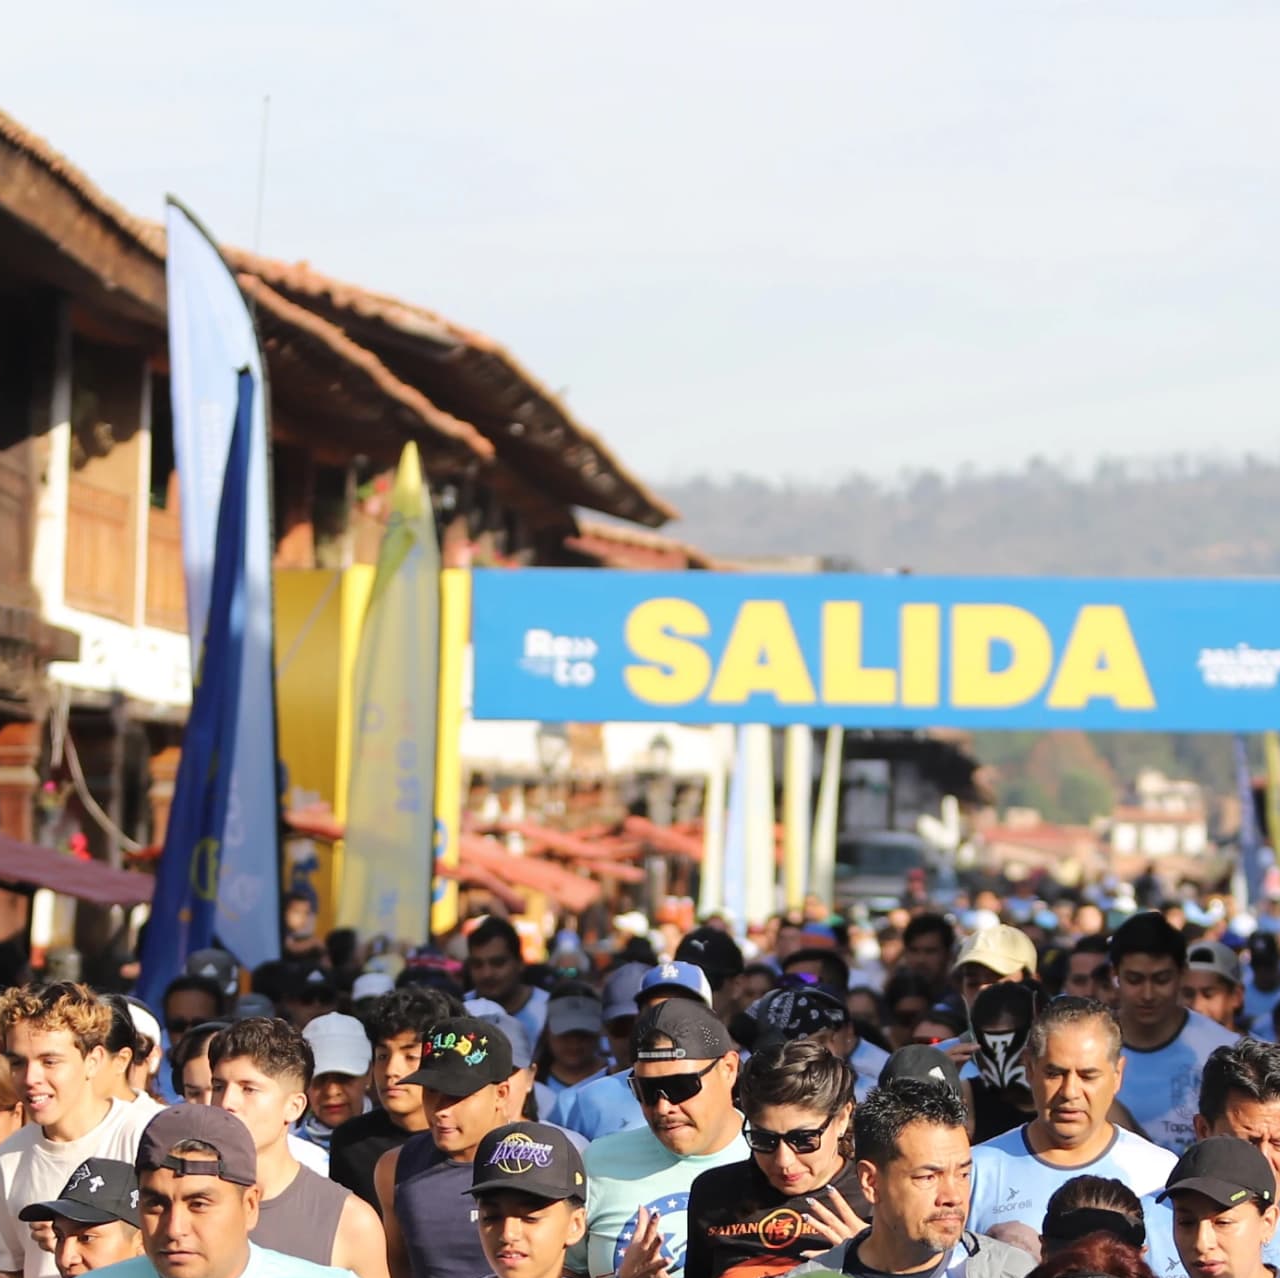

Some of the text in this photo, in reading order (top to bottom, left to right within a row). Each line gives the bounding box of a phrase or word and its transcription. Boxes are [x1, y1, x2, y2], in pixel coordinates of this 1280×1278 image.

[624, 597, 1157, 710] SALIDA
[484, 1140, 554, 1168] LAKERS
[991, 1198, 1033, 1214] sporelli
[707, 1222, 759, 1237] SAIYAN
